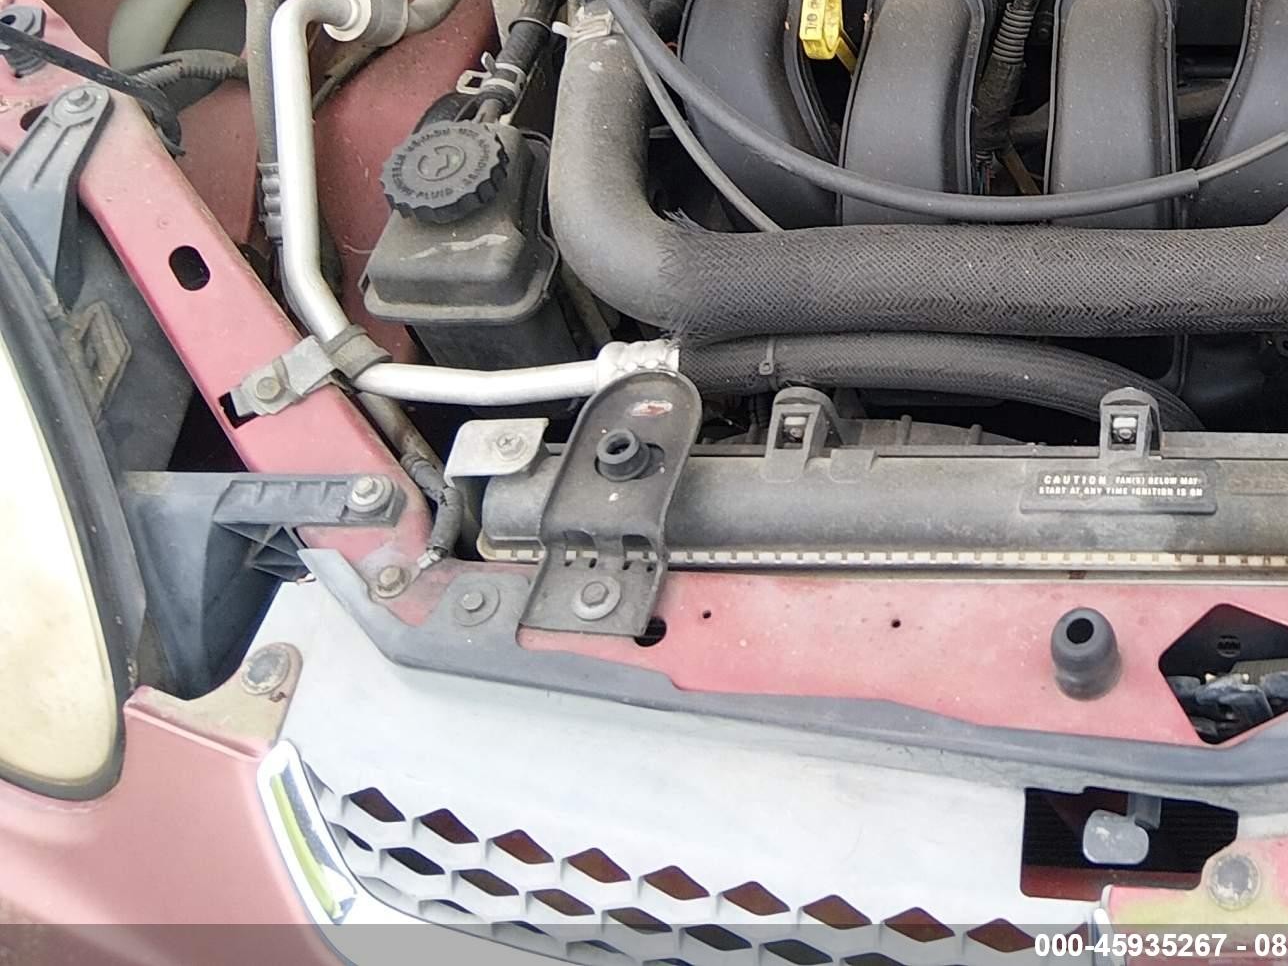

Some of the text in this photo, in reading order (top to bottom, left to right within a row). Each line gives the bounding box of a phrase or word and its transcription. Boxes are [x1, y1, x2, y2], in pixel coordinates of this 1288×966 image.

[1043, 474, 1107, 484] CAUTION
[1148, 476, 1177, 485] BELOW
[1039, 486, 1066, 494] START
[1084, 487, 1102, 495] ANY
[1106, 487, 1128, 495] TIME
[1131, 487, 1174, 496] IGNITION
[1177, 488, 1186, 496] IS
[1190, 488, 1203, 496] ON
